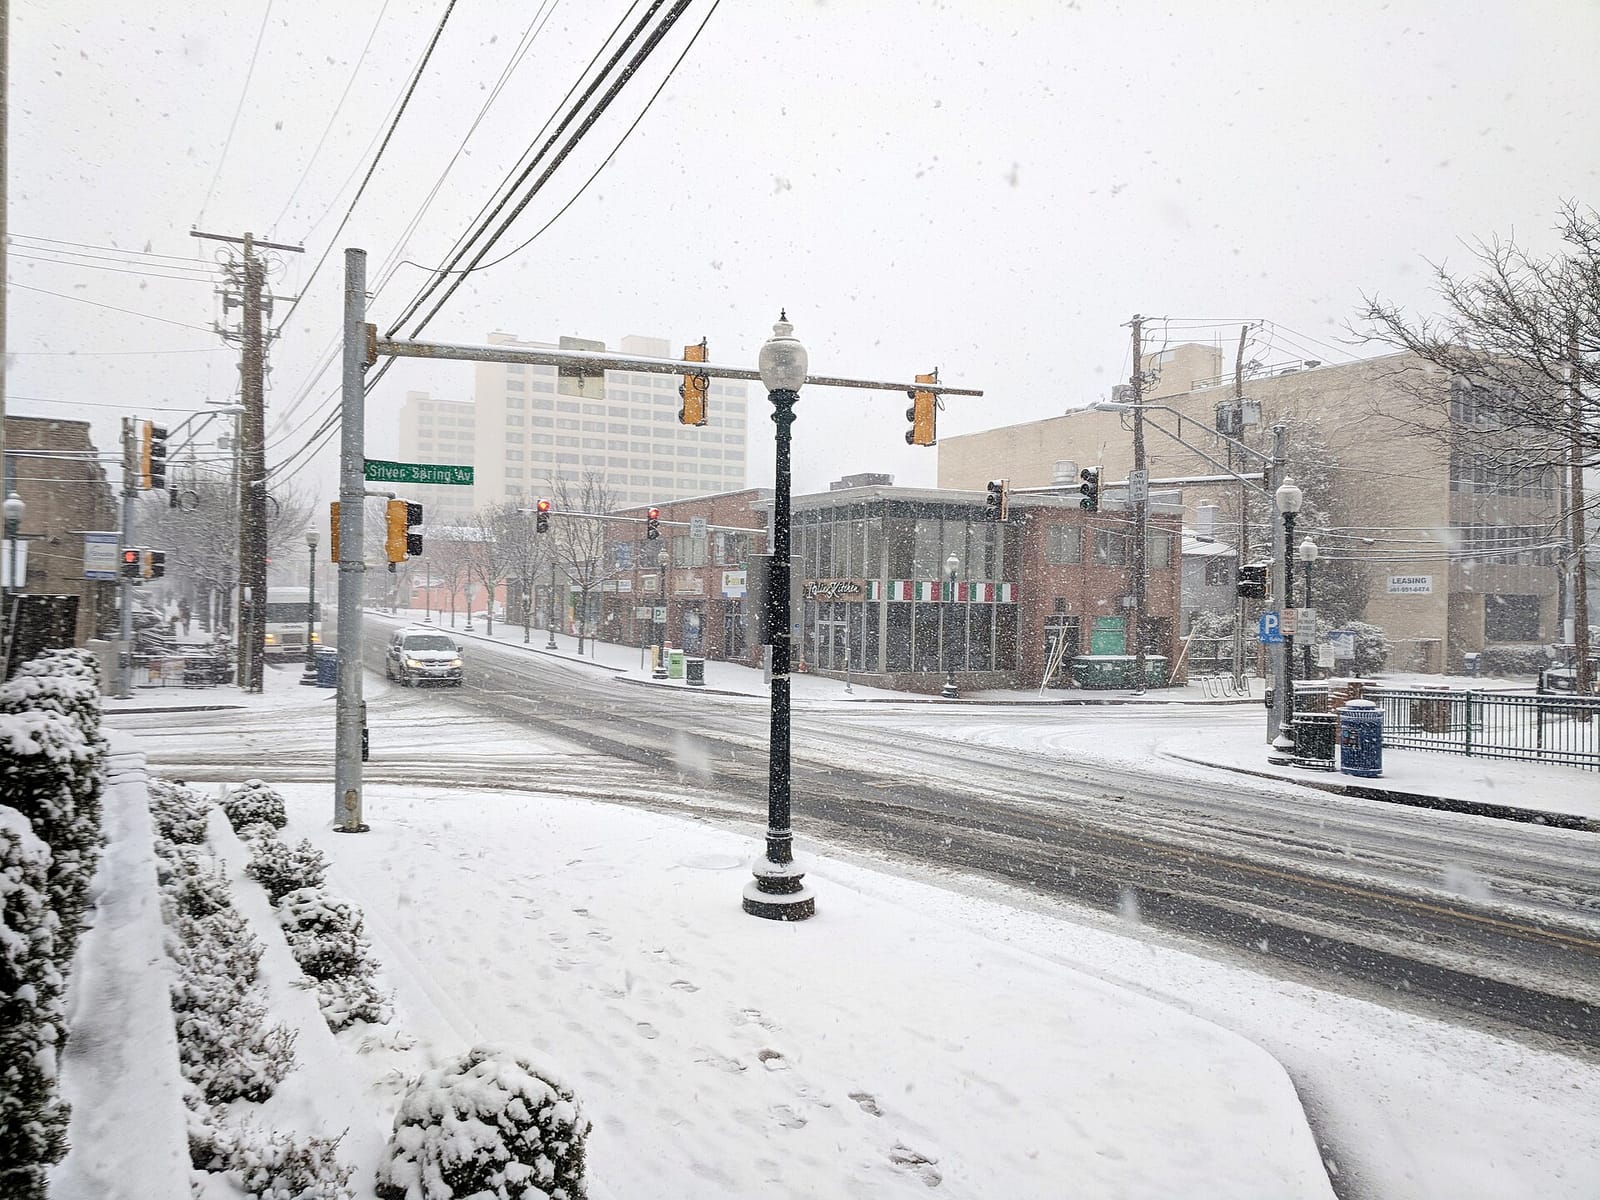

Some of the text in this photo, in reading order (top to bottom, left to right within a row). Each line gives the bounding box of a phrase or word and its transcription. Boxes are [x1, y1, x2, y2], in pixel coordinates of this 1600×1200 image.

[369, 465, 405, 479] Silver
[412, 467, 451, 482] Spring
[1265, 614, 1278, 634] P
